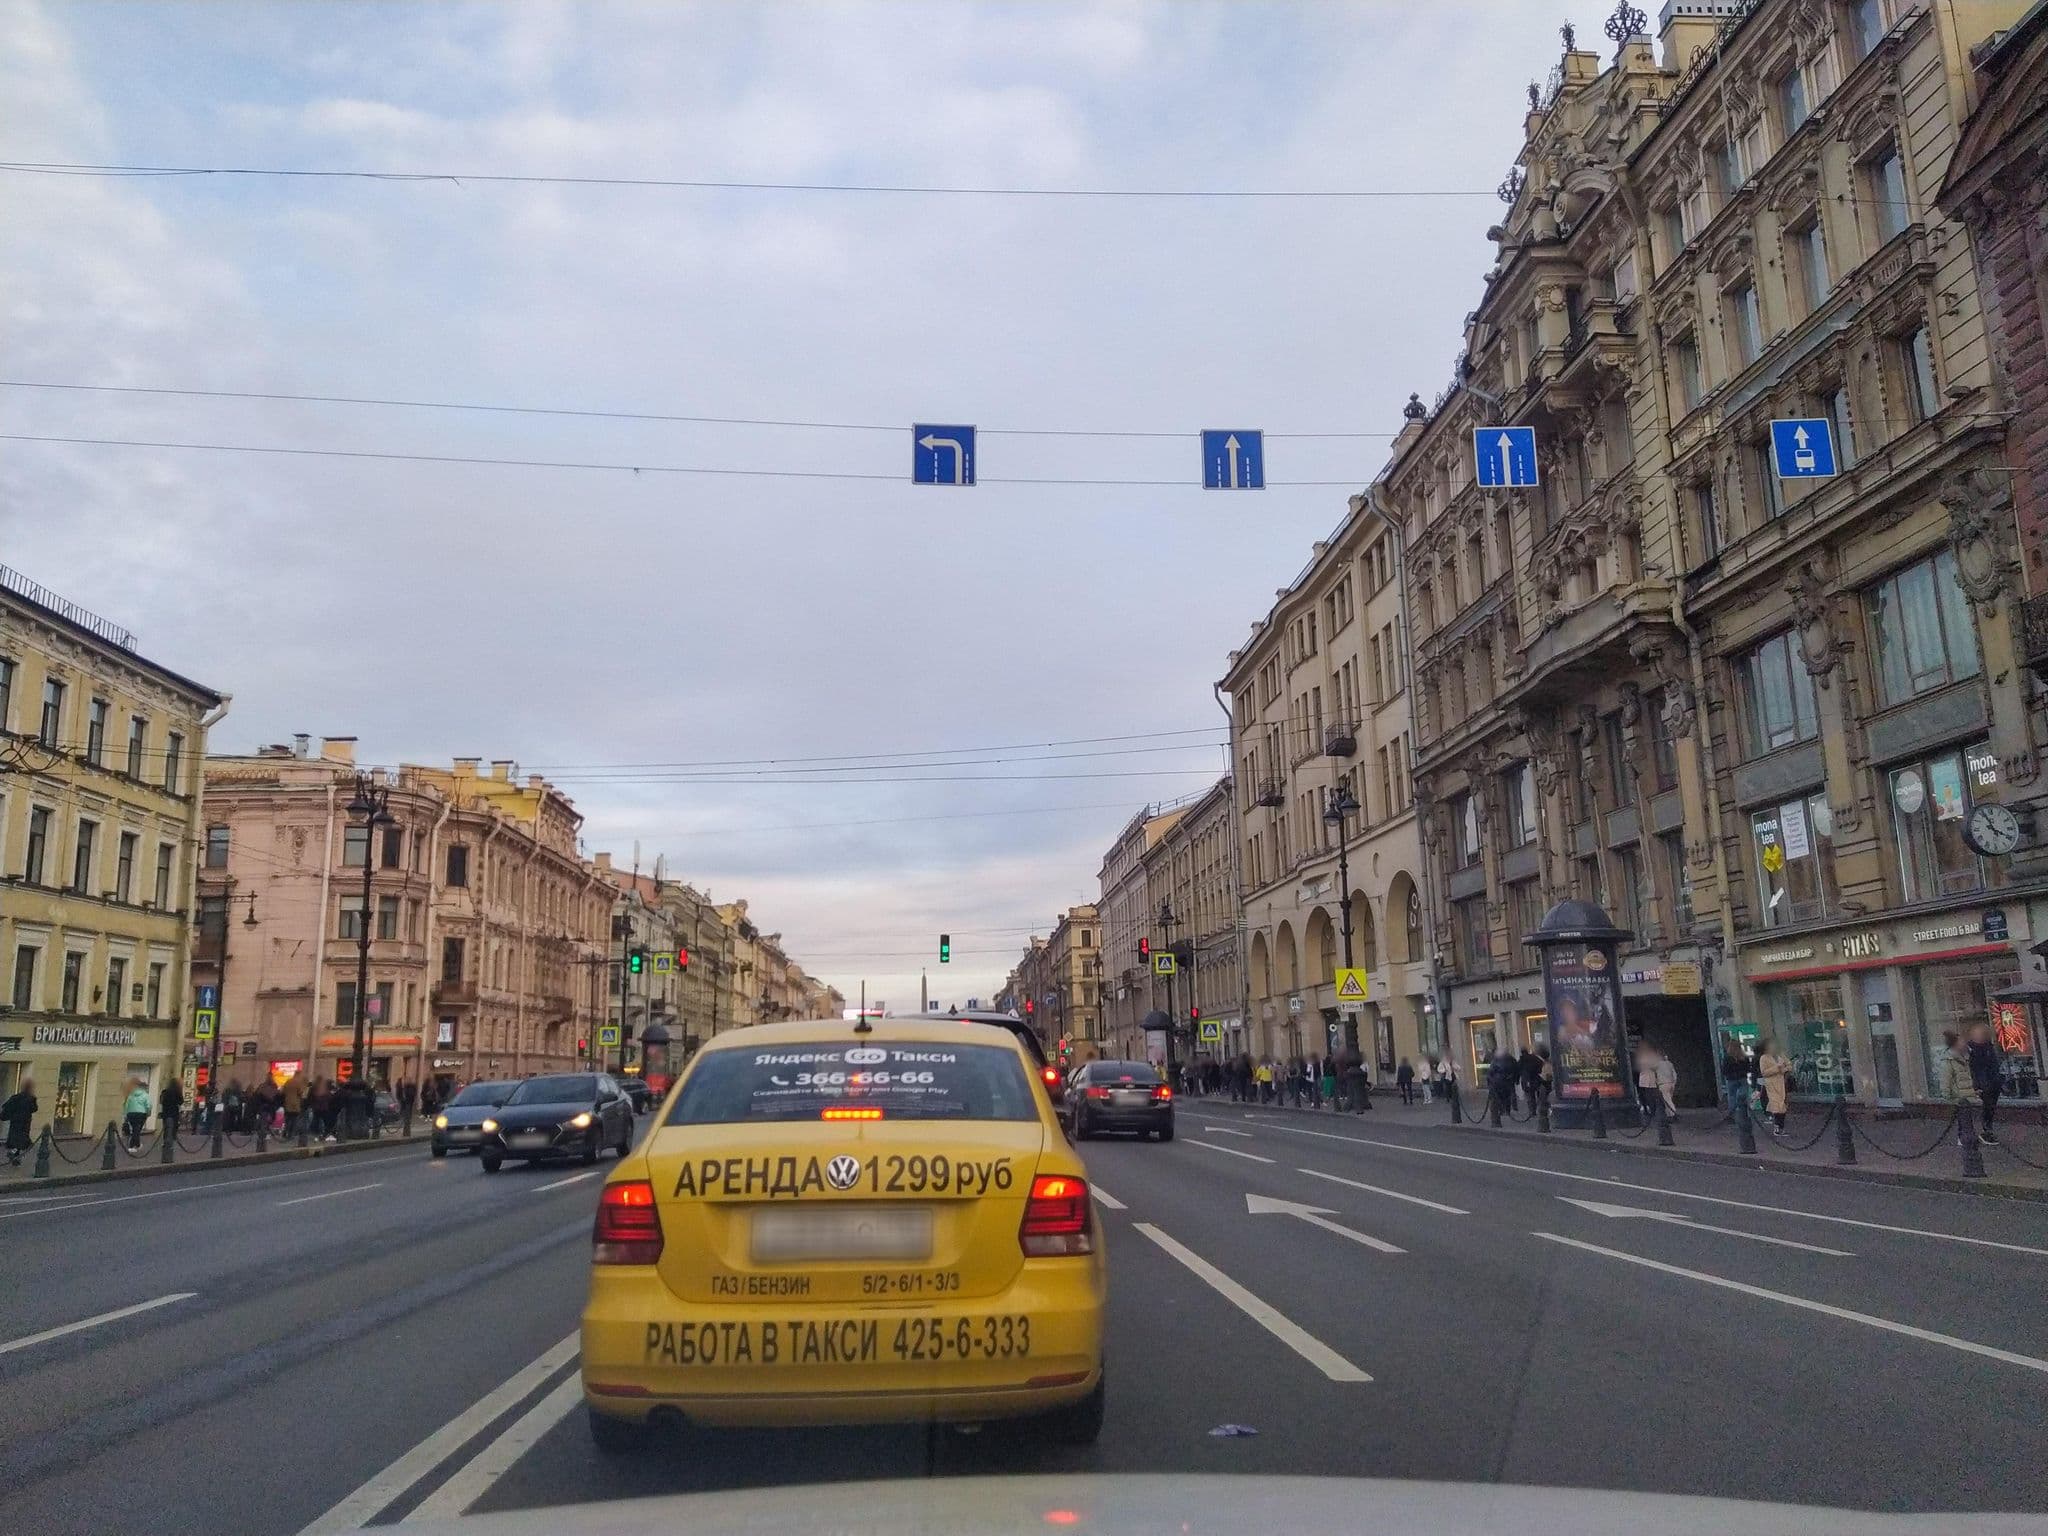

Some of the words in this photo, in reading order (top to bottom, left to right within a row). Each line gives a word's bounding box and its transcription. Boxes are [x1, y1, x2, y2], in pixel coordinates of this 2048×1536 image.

[1978, 770, 1996, 785] tea
[1755, 819, 1778, 833] mona
[1760, 833, 1775, 845] tea
[1912, 930, 1939, 942] STREET
[1940, 926, 1958, 938] FOOD
[1965, 923, 1980, 934] BAR
[36, 1026, 96, 1044] БРИТАНСКИЕ
[97, 1030, 136, 1045] ПЕКАРНИ
[754, 1053, 840, 1065] Яндекс
[890, 1051, 956, 1063] Такси
[795, 1072, 934, 1085] 366-66-66
[673, 1156, 825, 1198] АРЕНДА
[864, 1155, 950, 1193] 1299
[956, 1157, 1013, 1195] руб
[646, 1321, 753, 1364] РАБОТА
[762, 1322, 779, 1363] В
[788, 1320, 878, 1362] ТАКСИ
[893, 1316, 1030, 1361] 425-6-333
